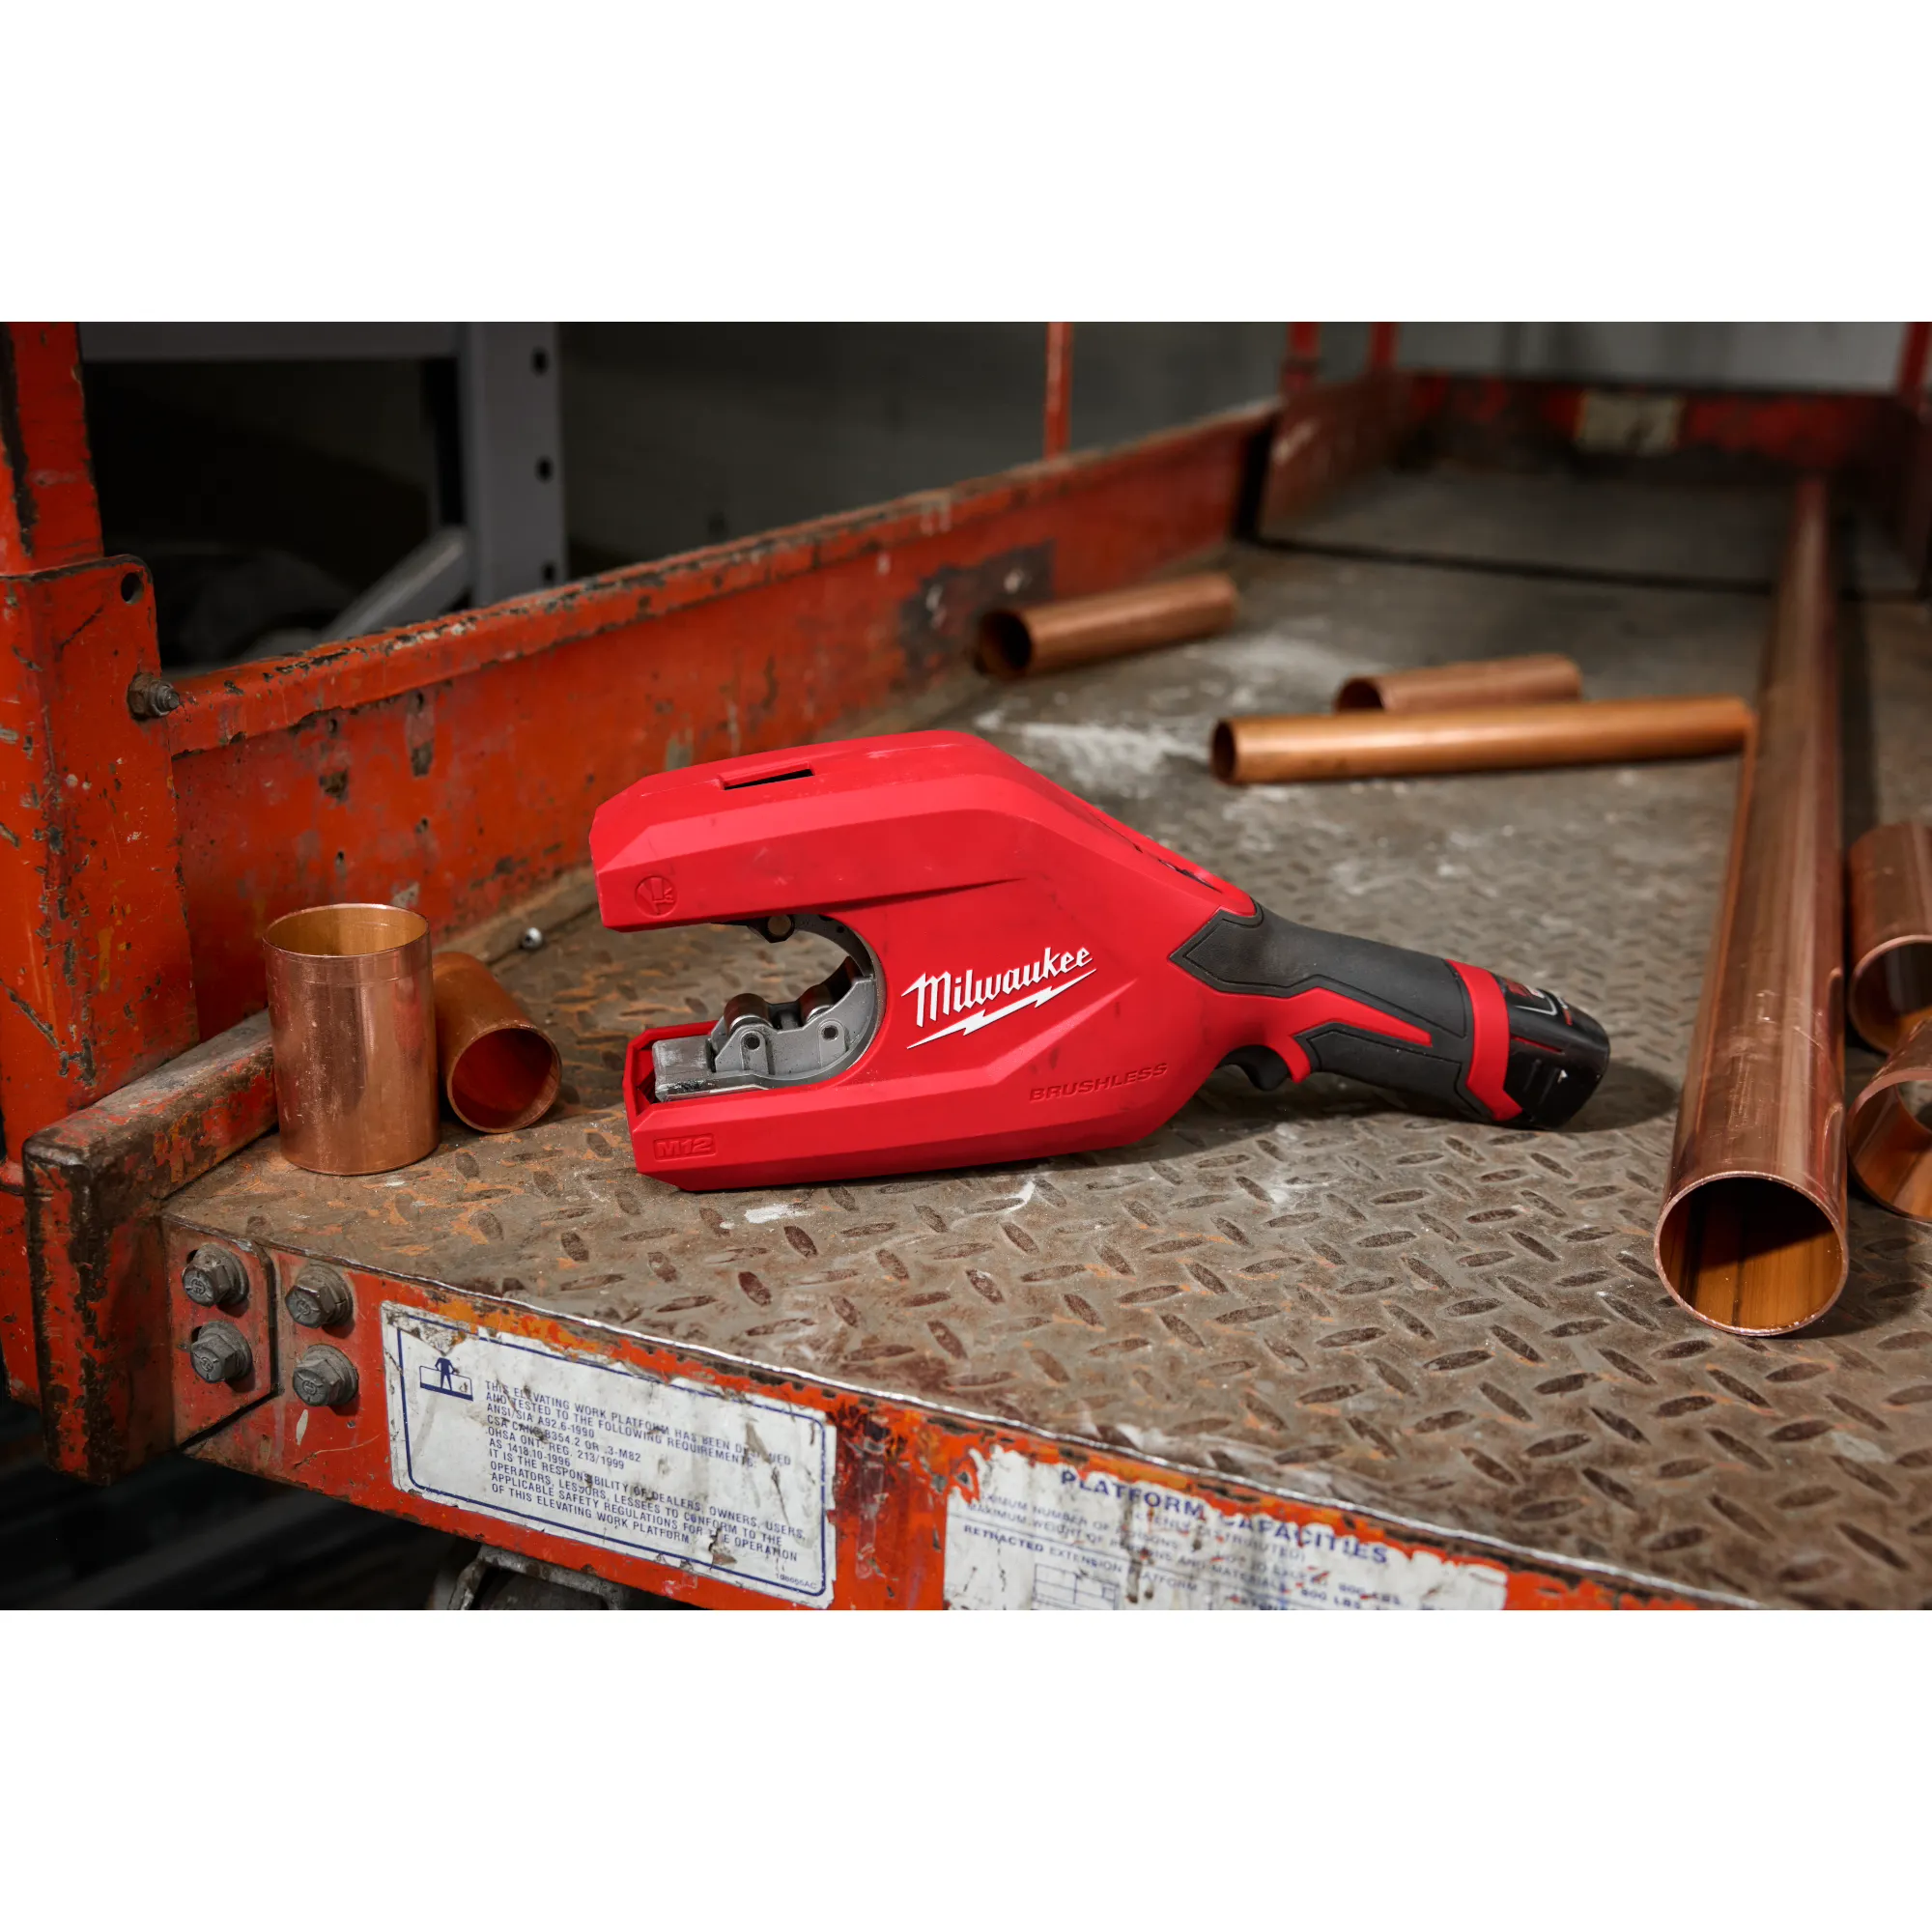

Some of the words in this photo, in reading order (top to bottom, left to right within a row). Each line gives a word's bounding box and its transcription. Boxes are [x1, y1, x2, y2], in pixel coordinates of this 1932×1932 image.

[900, 946, 1094, 1028] Milwaukee
[1029, 1062, 1168, 1103] BRUSHLESS
[656, 1136, 713, 1158] M12
[486, 1392, 507, 1405] AND
[512, 1398, 551, 1415] TESTED
[556, 1409, 569, 1421] TO
[575, 1413, 593, 1427] THE
[598, 1420, 662, 1444] FOLLOWING
[486, 1379, 509, 1394] THIS
[514, 1387, 570, 1410] ELVATING
[575, 1403, 606, 1420] WORK
[674, 1429, 696, 1442] HAS
[702, 1436, 730, 1450] BEEN
[735, 1443, 791, 1465] DNED
[487, 1403, 533, 1423] ANSI/SIA
[538, 1416, 595, 1438] A92.6-1990
[487, 1414, 508, 1428] CSA
[585, 1439, 599, 1452] OR
[489, 1437, 502, 1450] AS
[508, 1443, 571, 1467] 1418.10-1996
[489, 1448, 498, 1459] IT
[503, 1451, 514, 1463] IS
[517, 1455, 537, 1469] THE
[633, 1486, 647, 1498] OF
[549, 1443, 573, 1458] REG.
[578, 1450, 625, 1470] 213/1999
[491, 1461, 555, 1487] OPERATORS,
[614, 1493, 661, 1514] LESSEES
[667, 1507, 679, 1519] TO
[684, 1512, 737, 1535] CONFORM
[742, 1527, 756, 1540] TO
[762, 1533, 782, 1547] THE
[492, 1484, 505, 1494] OF
[509, 1488, 531, 1502] THIS
[537, 1496, 592, 1519] ELEVATING
[597, 1511, 628, 1528] WORK
[492, 1472, 554, 1497] APPLICABLE
[559, 1490, 599, 1509] SAFETY
[604, 1501, 677, 1530] REGULATIONS
[683, 1523, 703, 1536] FOR
[708, 1529, 730, 1544] TE
[1061, 1468, 1205, 1520] PLATFORM
[1219, 1514, 1388, 1564] CAPACITIES
[964, 1523, 1044, 1553] RETRACTED
[1128, 1565, 1198, 1592] PATFORM
